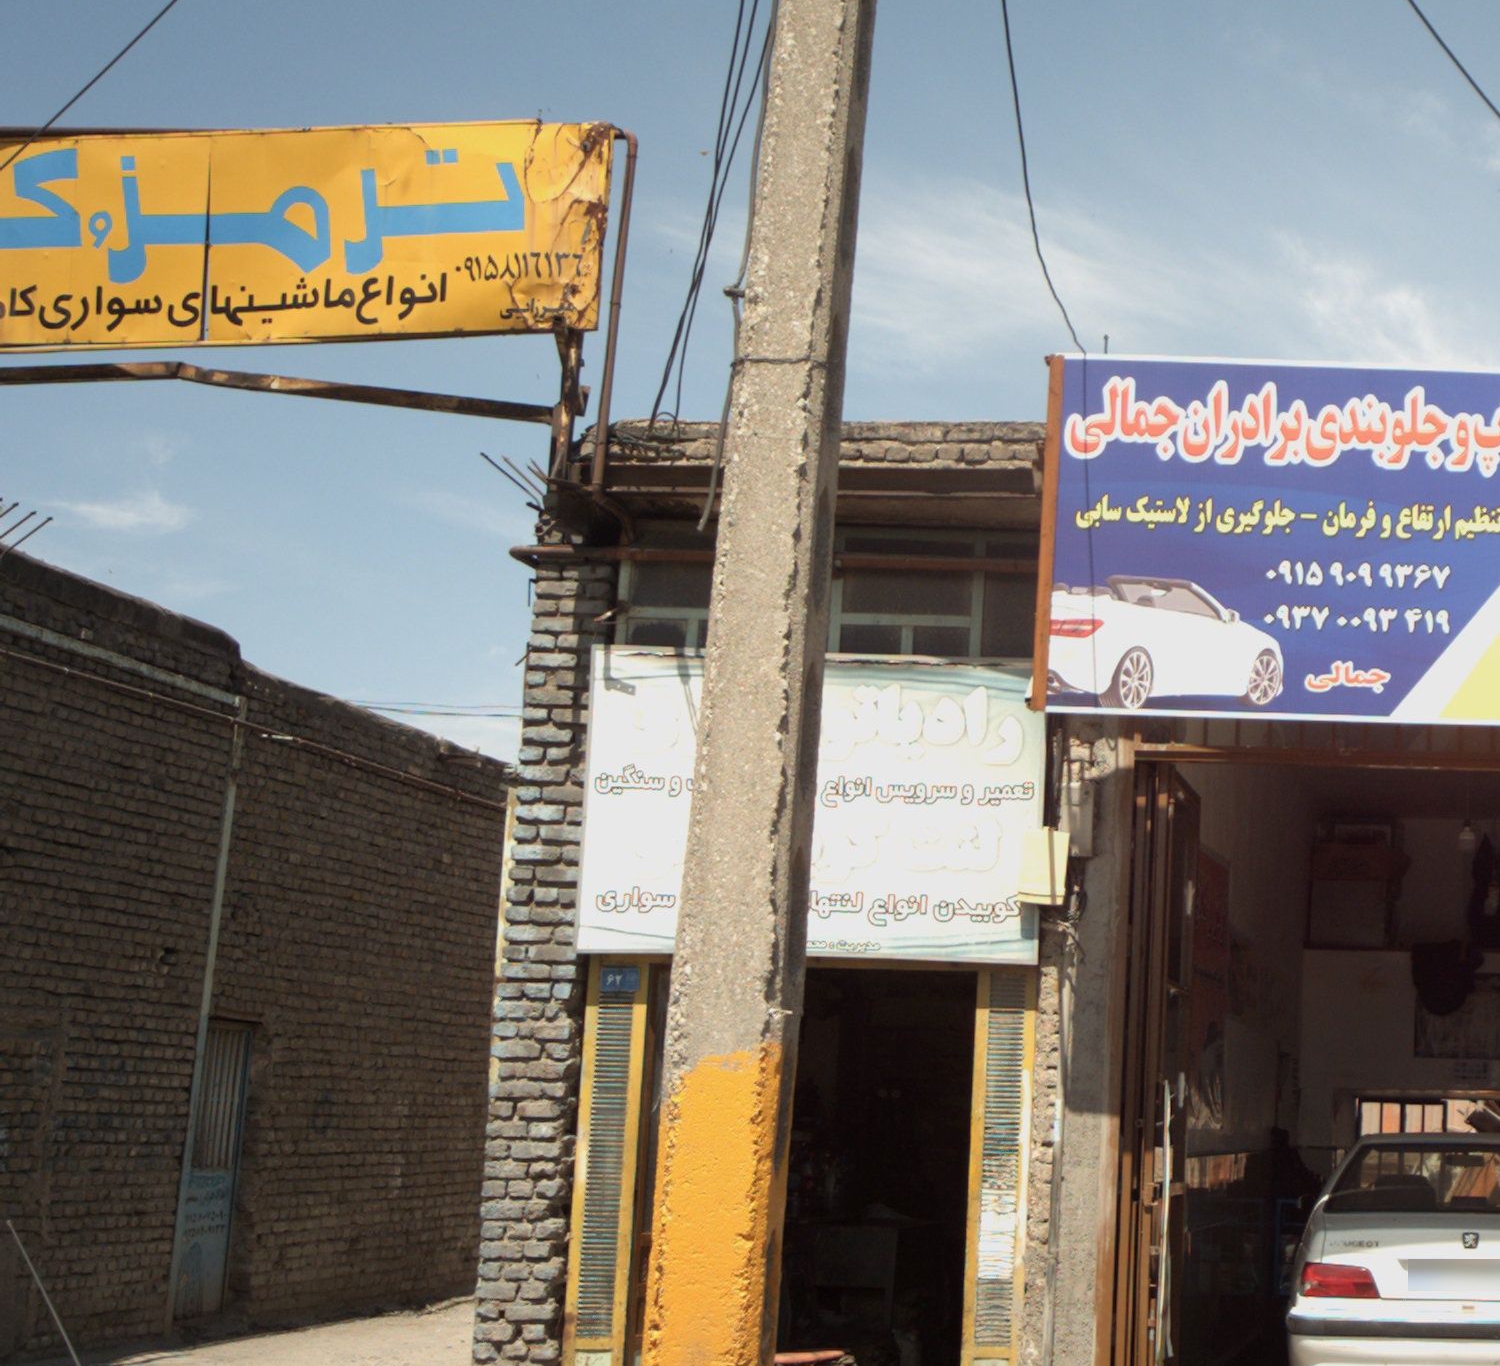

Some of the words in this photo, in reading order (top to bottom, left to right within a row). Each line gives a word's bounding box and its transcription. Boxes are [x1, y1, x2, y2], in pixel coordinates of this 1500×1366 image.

[108, 148, 526, 285] ترمز
[38, 285, 162, 332] سواری
[357, 272, 447, 324] انواع
[1065, 376, 1185, 461] جمالی
[1179, 380, 1306, 467] برادران
[1303, 385, 1449, 469] جلوبندی
[1075, 493, 1123, 531] سابی
[1126, 494, 1191, 528] لاستیک
[1194, 498, 1214, 534] از
[1216, 501, 1297, 535] جلوگیری
[1321, 500, 1377, 538] فرمان
[1379, 512, 1393, 538] و
[1396, 502, 1451, 539] ارتفاع
[1265, 559, 1324, 587] ۰۹۱۵
[1330, 561, 1374, 588] ۹۰۹
[1379, 563, 1451, 590] ۹۳۶۷
[1263, 604, 1330, 631] ۰۹۳۷
[1405, 608, 1451, 635] ۴۱۹
[1304, 660, 1391, 694] جمالی
[594, 763, 666, 796] سنگین
[667, 775, 684, 798] و
[820, 776, 873, 809] انواع
[875, 780, 957, 805] سرویس
[960, 786, 974, 806] و
[977, 780, 1035, 807] تعمیر
[595, 886, 677, 914] سواری
[867, 894, 929, 927] انواع
[932, 893, 1024, 925] کوبیدن
